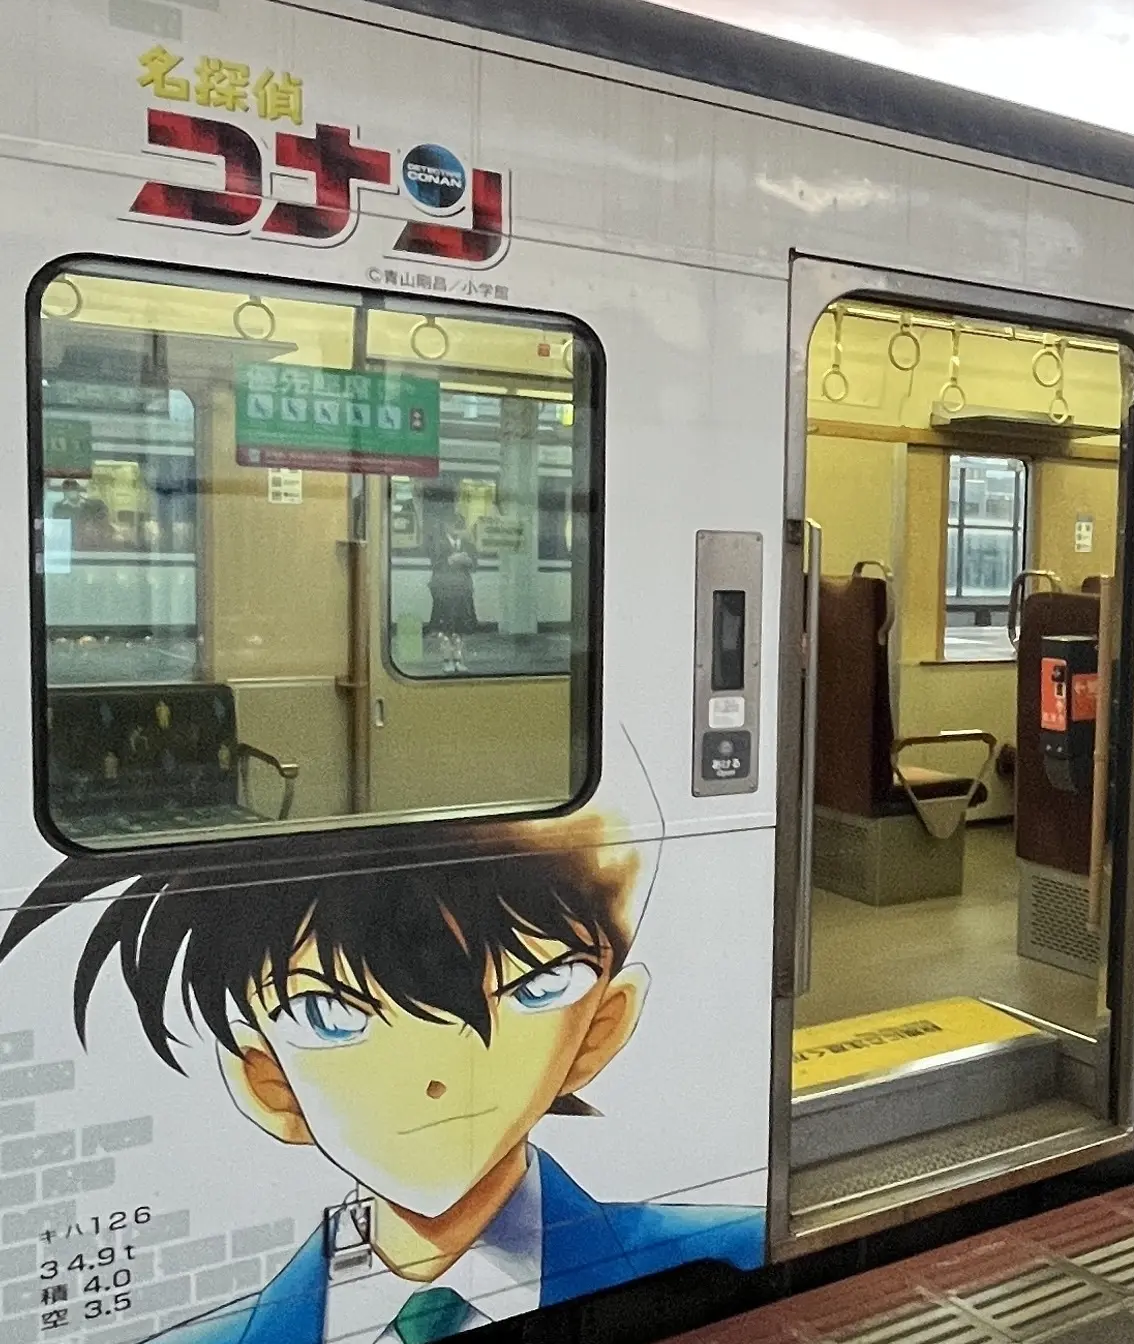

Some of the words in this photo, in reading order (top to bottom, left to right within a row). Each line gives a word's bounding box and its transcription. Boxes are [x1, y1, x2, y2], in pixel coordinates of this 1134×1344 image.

[137, 44, 304, 125] 名探偵
[129, 107, 504, 262] コナン
[407, 171, 462, 189] CONAN
[83, 1268, 132, 1294] 4.0
[84, 1291, 132, 1320] 3.5
